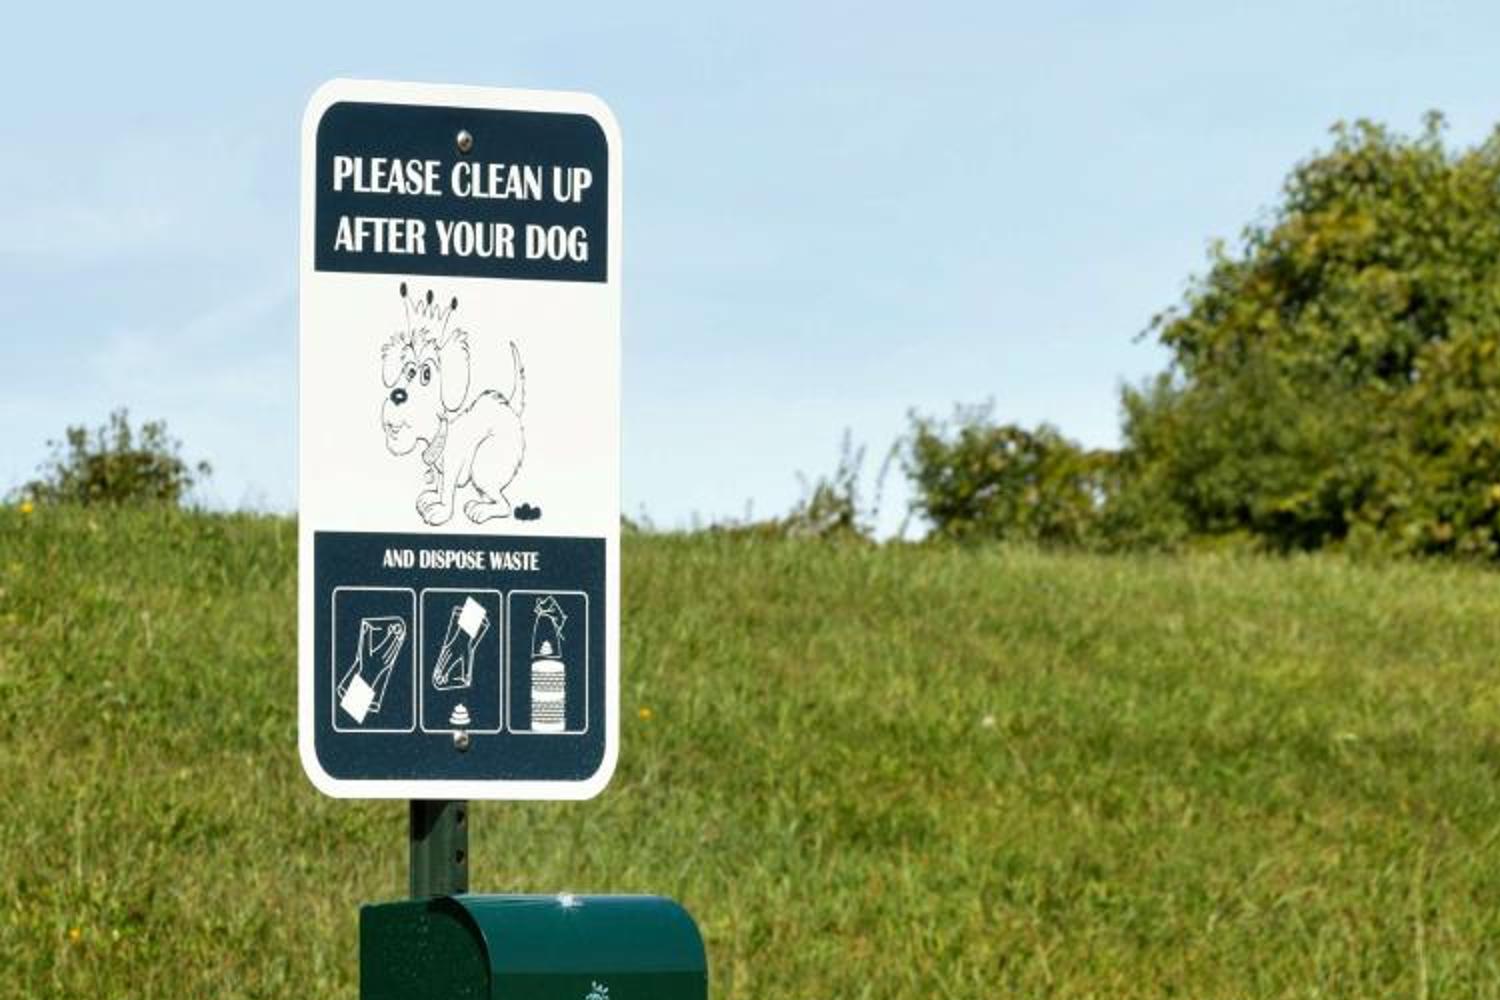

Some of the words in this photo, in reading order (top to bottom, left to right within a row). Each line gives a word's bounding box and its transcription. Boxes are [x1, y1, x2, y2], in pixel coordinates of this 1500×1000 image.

[333, 155, 442, 196] PLEASE
[451, 161, 543, 200] CLEAN
[553, 166, 593, 203] UP
[334, 215, 426, 255] AFTER
[435, 219, 515, 258] YOUR
[525, 224, 589, 262] DOG
[383, 549, 415, 569] AND
[419, 550, 486, 571] DISPOSE
[489, 551, 540, 572] WASTE
